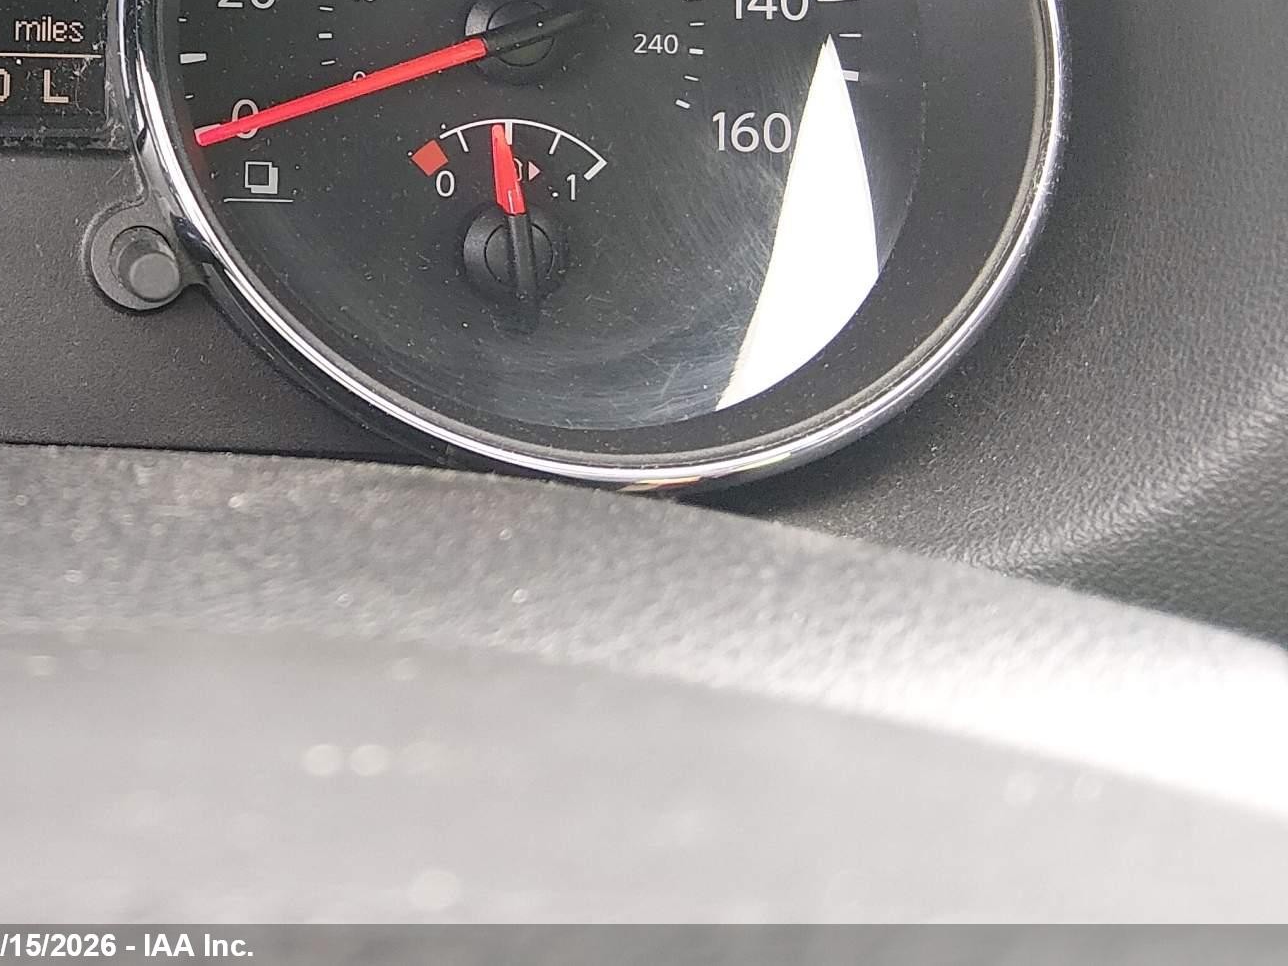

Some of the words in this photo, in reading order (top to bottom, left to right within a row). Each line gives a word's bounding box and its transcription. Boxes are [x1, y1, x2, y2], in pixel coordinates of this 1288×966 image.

[15, 16, 84, 42] miles
[634, 33, 679, 54] 240
[43, 69, 69, 104] L
[712, 112, 792, 153] 160
[435, 170, 455, 197] 0
[566, 174, 576, 201] 1
